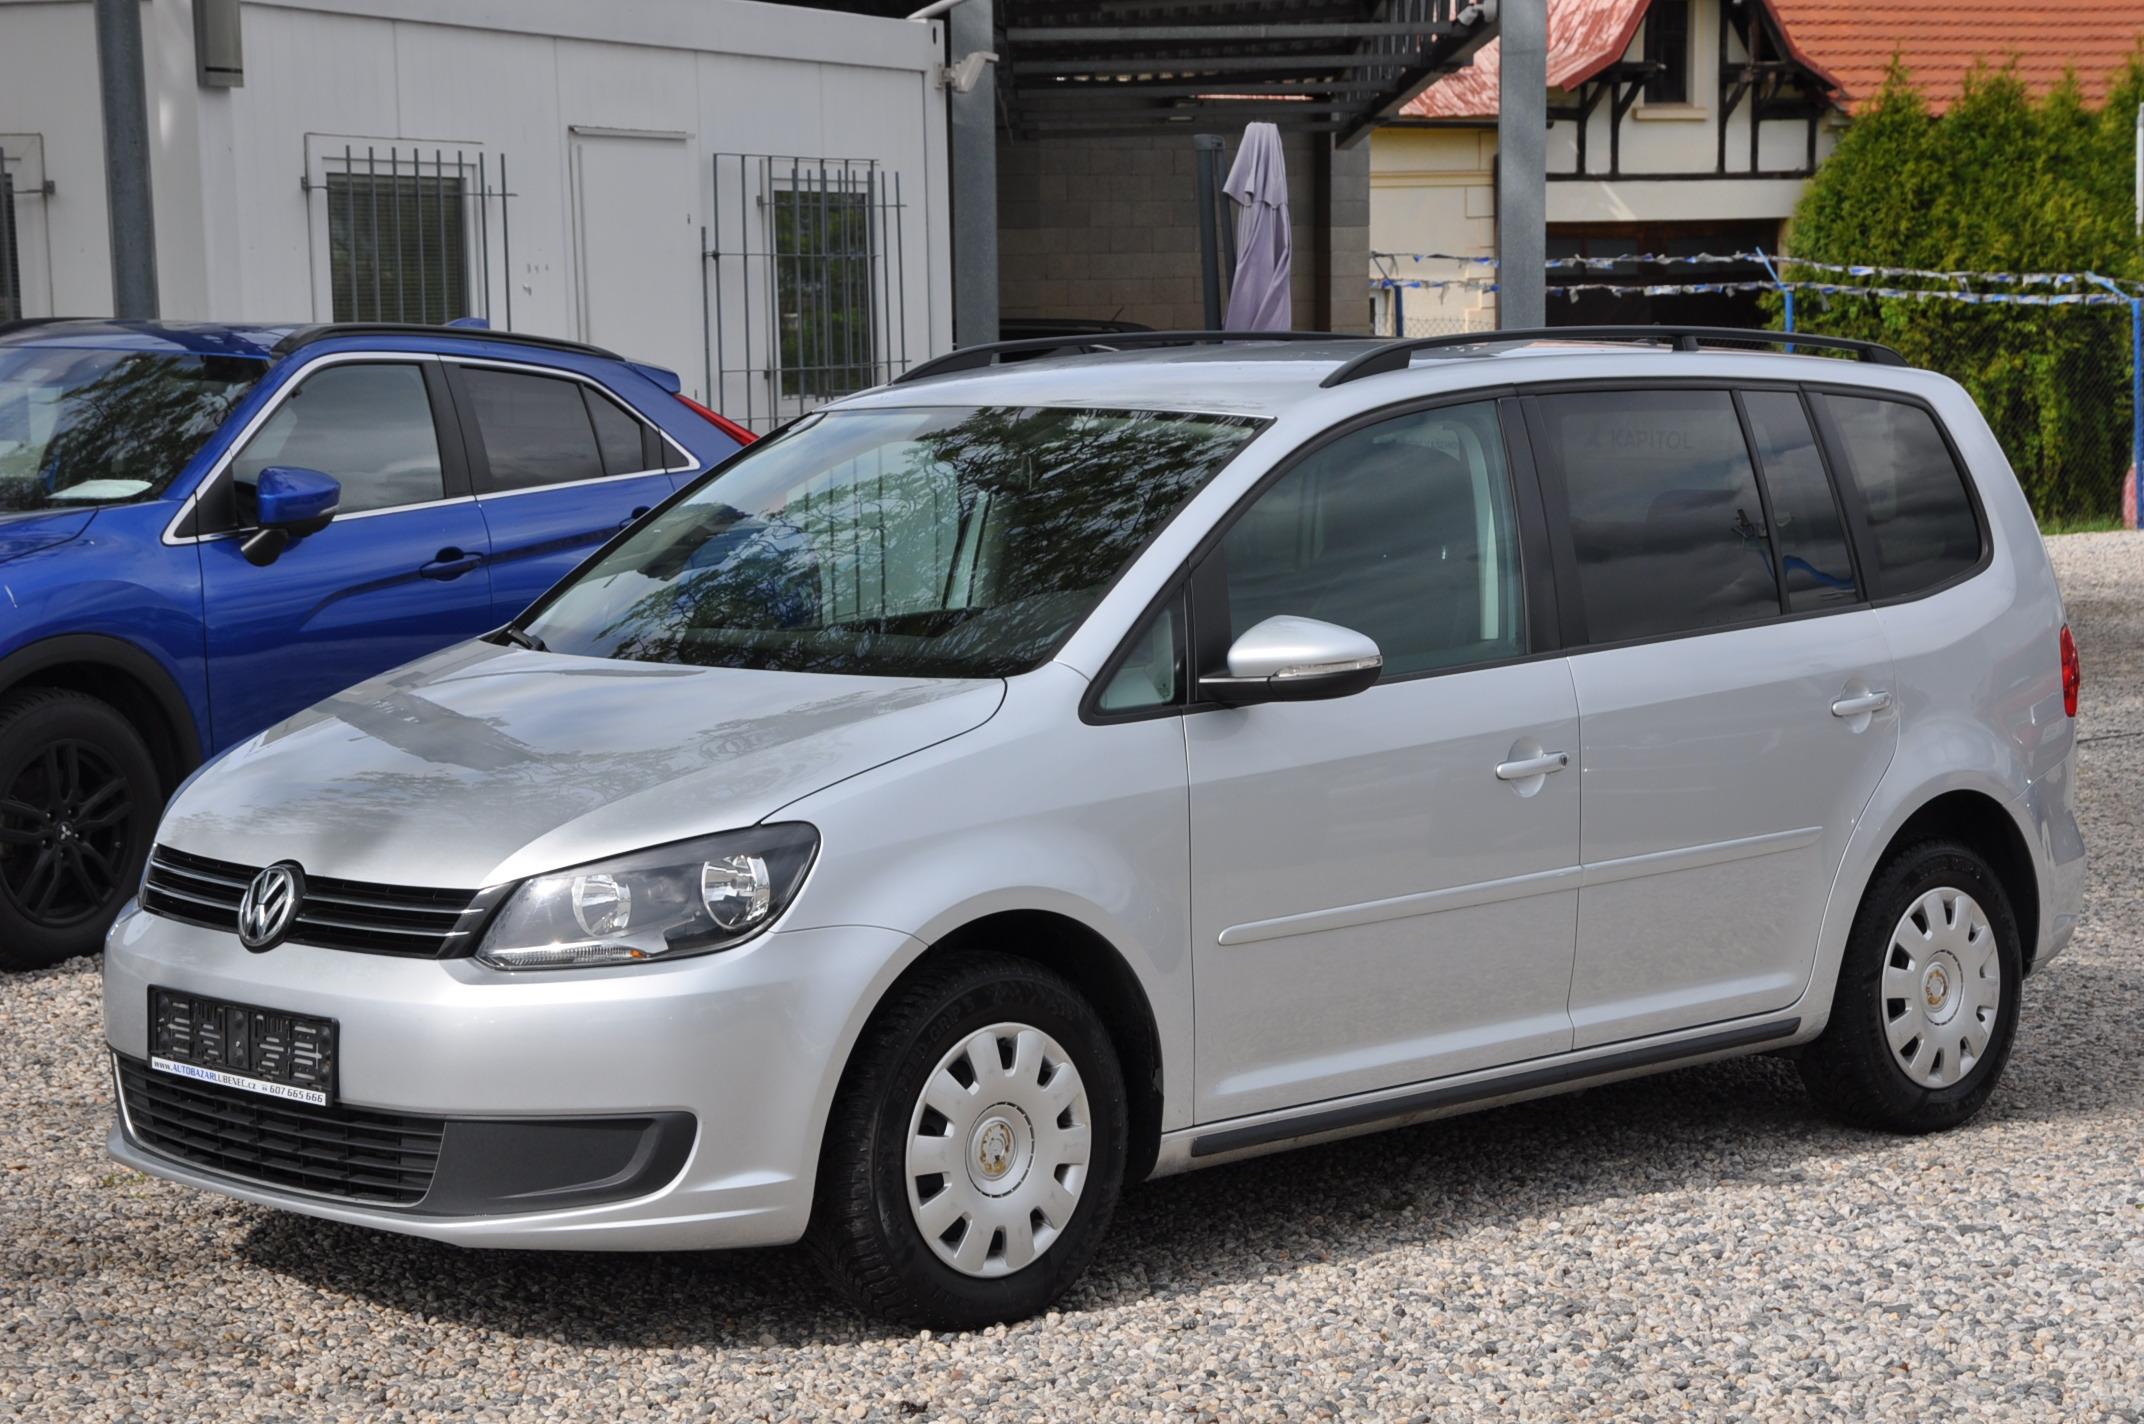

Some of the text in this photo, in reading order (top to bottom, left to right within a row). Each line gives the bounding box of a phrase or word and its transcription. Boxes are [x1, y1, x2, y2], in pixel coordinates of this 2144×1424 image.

[1610, 427, 1695, 449] KAPITOL
[241, 867, 293, 944] VW
[269, 1085, 286, 1095] 607
[287, 1088, 304, 1099] 665
[305, 1091, 323, 1103] 666
